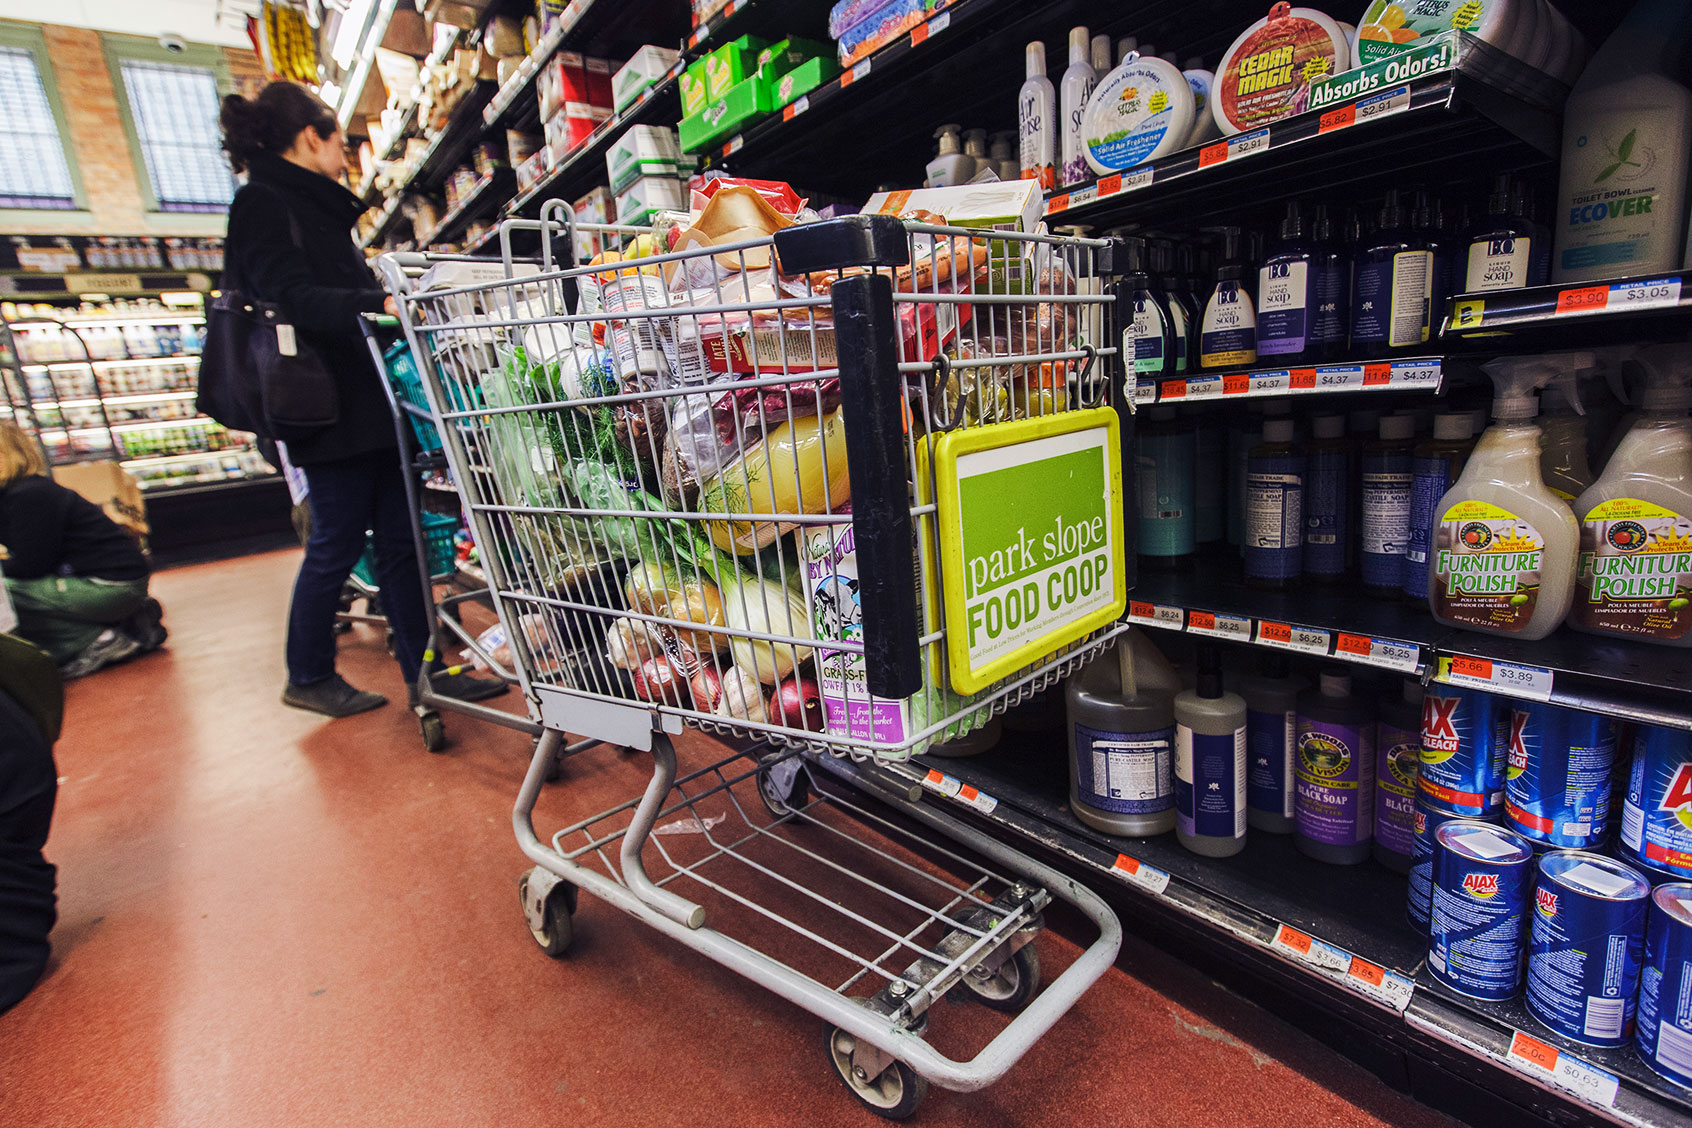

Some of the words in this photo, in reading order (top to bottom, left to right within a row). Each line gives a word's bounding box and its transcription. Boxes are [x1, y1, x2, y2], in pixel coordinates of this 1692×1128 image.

[1413, 6, 1444, 17] MAGIC
[1458, 13, 1473, 21] Baking
[1365, 43, 1387, 54] Solid
[1239, 44, 1295, 77] CEDAR
[1121, 69, 1145, 80] Absorbs
[1237, 63, 1295, 97] MAGIC
[1312, 70, 1379, 107] Absorbs
[1385, 45, 1448, 83] Odors!
[1319, 113, 1348, 130] $5.82
[1361, 100, 1392, 117] $2.91
[1097, 145, 1115, 154] Solid
[1115, 142, 1126, 150] Air
[1126, 133, 1162, 147] Freshener
[1238, 139, 1262, 153] $2.91
[1127, 174, 1147, 185] $2.91
[1572, 193, 1602, 205] TOILET
[1604, 188, 1632, 199] BOWL
[1569, 195, 1653, 225] ECOVER
[1488, 239, 1515, 256] EO
[1269, 262, 1290, 279] EO
[1488, 265, 1511, 273] HAND
[1483, 271, 1513, 283] soap
[1217, 290, 1239, 305] EO
[1267, 294, 1291, 303] soap
[1565, 291, 1605, 306] $3.90
[1627, 287, 1670, 300] $3.05
[1215, 316, 1240, 325] soap
[1322, 375, 1349, 386] $4.37
[1403, 370, 1434, 382] $4.37
[1190, 384, 1212, 394] $4.37
[1224, 381, 1249, 391] $11.65
[1256, 379, 1280, 390] $4.37
[968, 527, 1038, 600] park
[1043, 514, 1105, 558] slope
[1438, 551, 1540, 574] FURNITURE
[1579, 553, 1692, 577] FURNITUR
[1449, 573, 1516, 594] POLISH
[1593, 577, 1676, 599] POLISH
[967, 580, 1040, 649] FOOD
[1047, 552, 1109, 612] COOP
[1161, 610, 1180, 619] $6.24
[1190, 616, 1215, 627] $12.50
[1218, 621, 1240, 631] $6.25
[982, 645, 993, 655] Food
[1027, 622, 1042, 633] Working
[1264, 626, 1292, 638] $12.50
[1298, 633, 1323, 644] $6.25
[1343, 637, 1374, 651] $12.50
[1382, 645, 1410, 659] $6.25
[1452, 659, 1483, 672] $5.66
[1500, 668, 1533, 682] $3.89
[853, 682, 864, 694] 1%
[1311, 733, 1350, 758] WOODS
[1423, 739, 1458, 751] BLEACH
[1316, 759, 1350, 777] VISION
[1309, 784, 1330, 794] PURE
[1315, 777, 1330, 786] SKIN
[1298, 784, 1322, 801] BLACK
[1322, 794, 1348, 805] SOAP
[1464, 874, 1498, 889] AJAX
[1536, 888, 1558, 909] AJAX
[1283, 931, 1307, 949] $7.32
[1316, 950, 1341, 967] $3.66
[1514, 1040, 1546, 1062] 72.0c
[1563, 1064, 1600, 1088] $0.63
